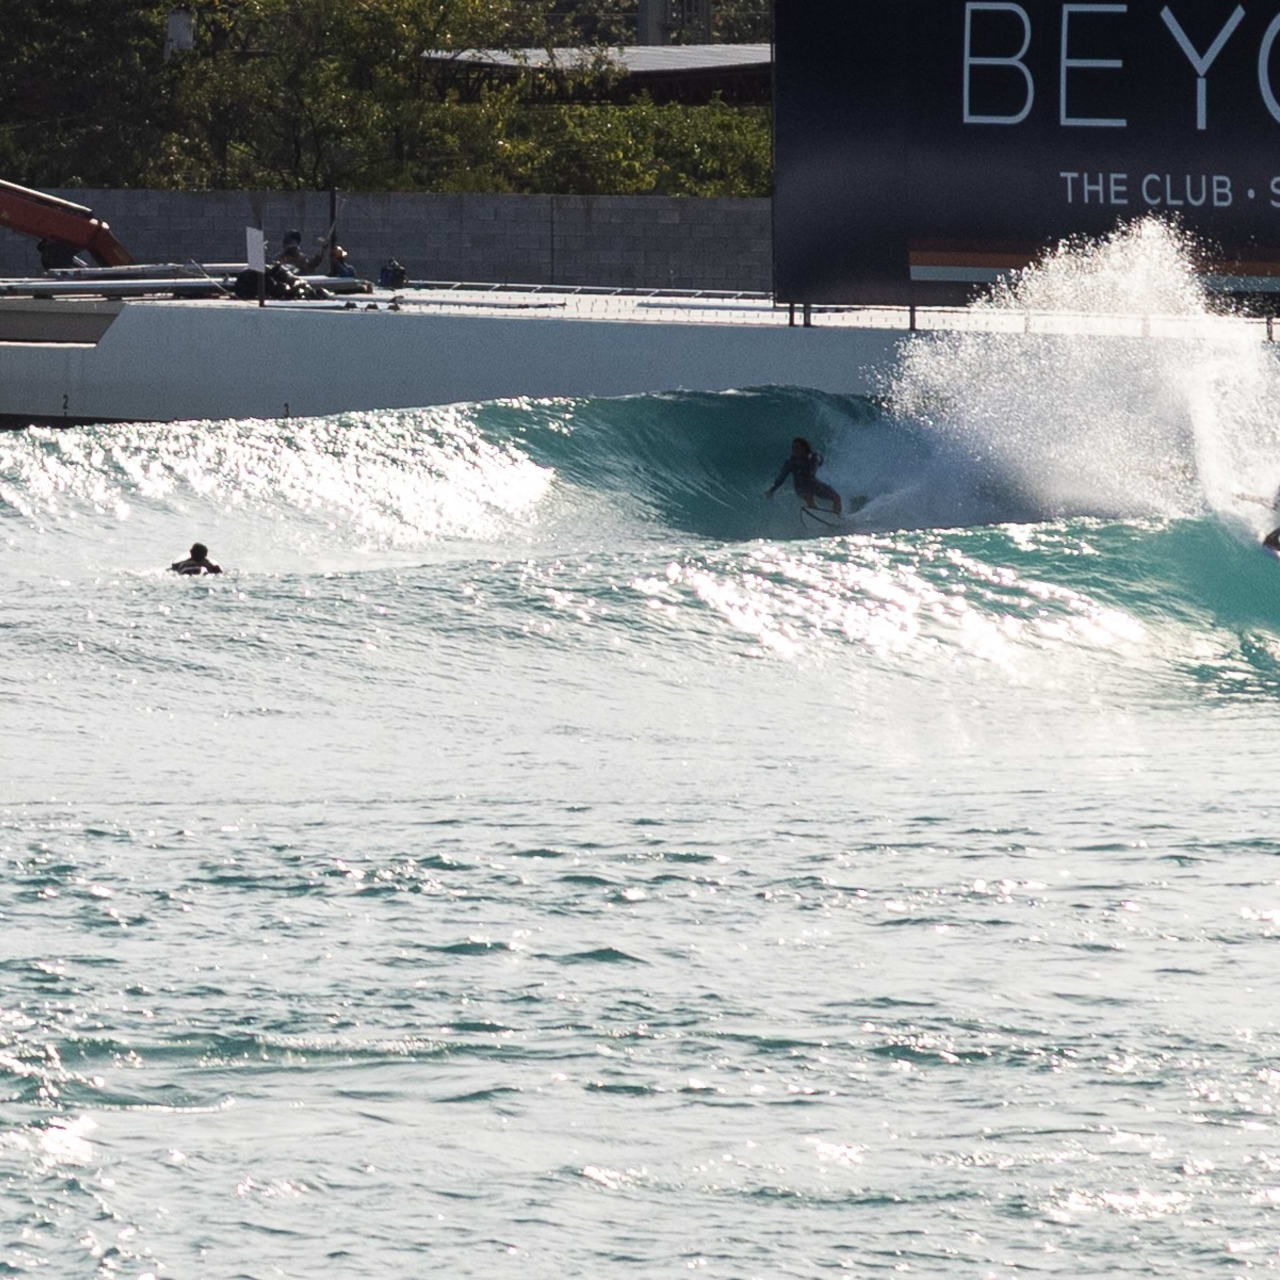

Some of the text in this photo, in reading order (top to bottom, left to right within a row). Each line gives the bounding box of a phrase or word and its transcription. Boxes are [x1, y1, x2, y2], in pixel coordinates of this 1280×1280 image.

[963, 1, 1280, 130] BEY
[1060, 171, 1128, 205] THE
[1142, 174, 1233, 207] CLUB
